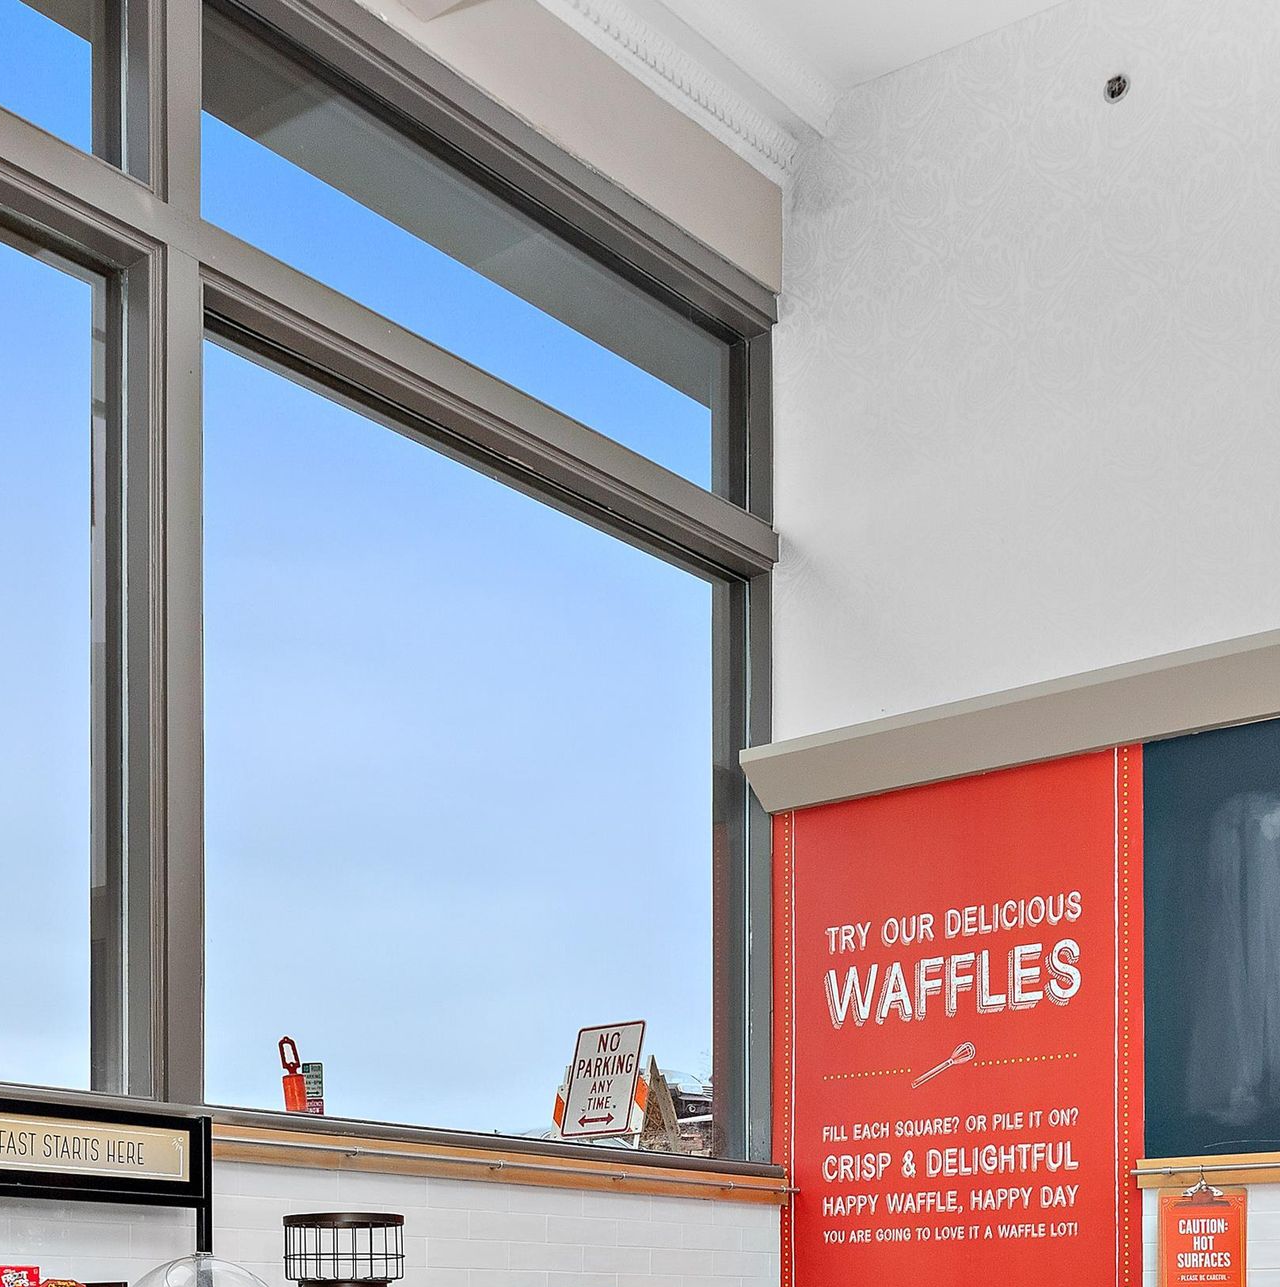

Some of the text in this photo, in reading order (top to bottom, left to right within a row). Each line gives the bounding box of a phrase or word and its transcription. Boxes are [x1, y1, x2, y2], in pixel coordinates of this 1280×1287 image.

[825, 890, 1082, 955] TRY OUR DELICIOUS
[824, 938, 1082, 1030] WAFFLES
[597, 1032, 620, 1053] NO
[576, 1054, 634, 1079] PARKING
[590, 1080, 613, 1094] ANY
[587, 1096, 612, 1111] TIME
[822, 1107, 1079, 1142] FILL EACH SQUARE? OR PILE IT ON?
[43, 1134, 99, 1161] STARTS
[107, 1140, 144, 1165] HERE
[822, 1141, 1079, 1182] CRISP & DELIGHTFUL
[822, 1184, 1079, 1217] HAPPY WAFFLE, HAPPY DAY
[823, 1222, 1078, 1244] YOU ARE GOING TO LOVE IT A WAFFLE LOT!
[1178, 1218, 1229, 1234] CAUTION:
[1193, 1235, 1214, 1251] HOT
[1177, 1252, 1231, 1268] SURFACES
